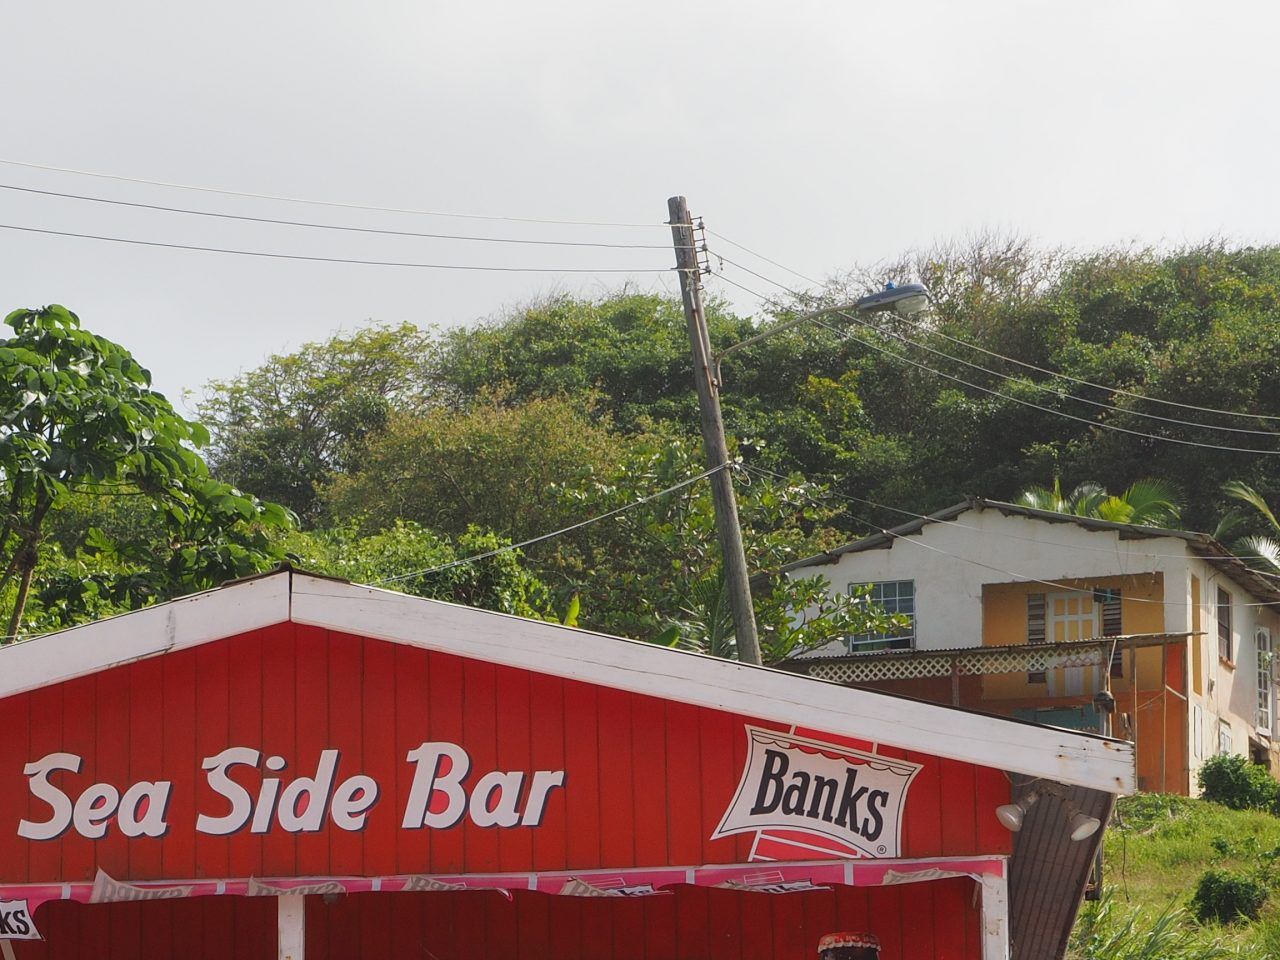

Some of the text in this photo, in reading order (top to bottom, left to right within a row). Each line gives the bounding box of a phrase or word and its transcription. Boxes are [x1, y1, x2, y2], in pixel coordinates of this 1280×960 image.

[17, 741, 566, 840] Sea Side Bar
[749, 748, 890, 842] Banks
